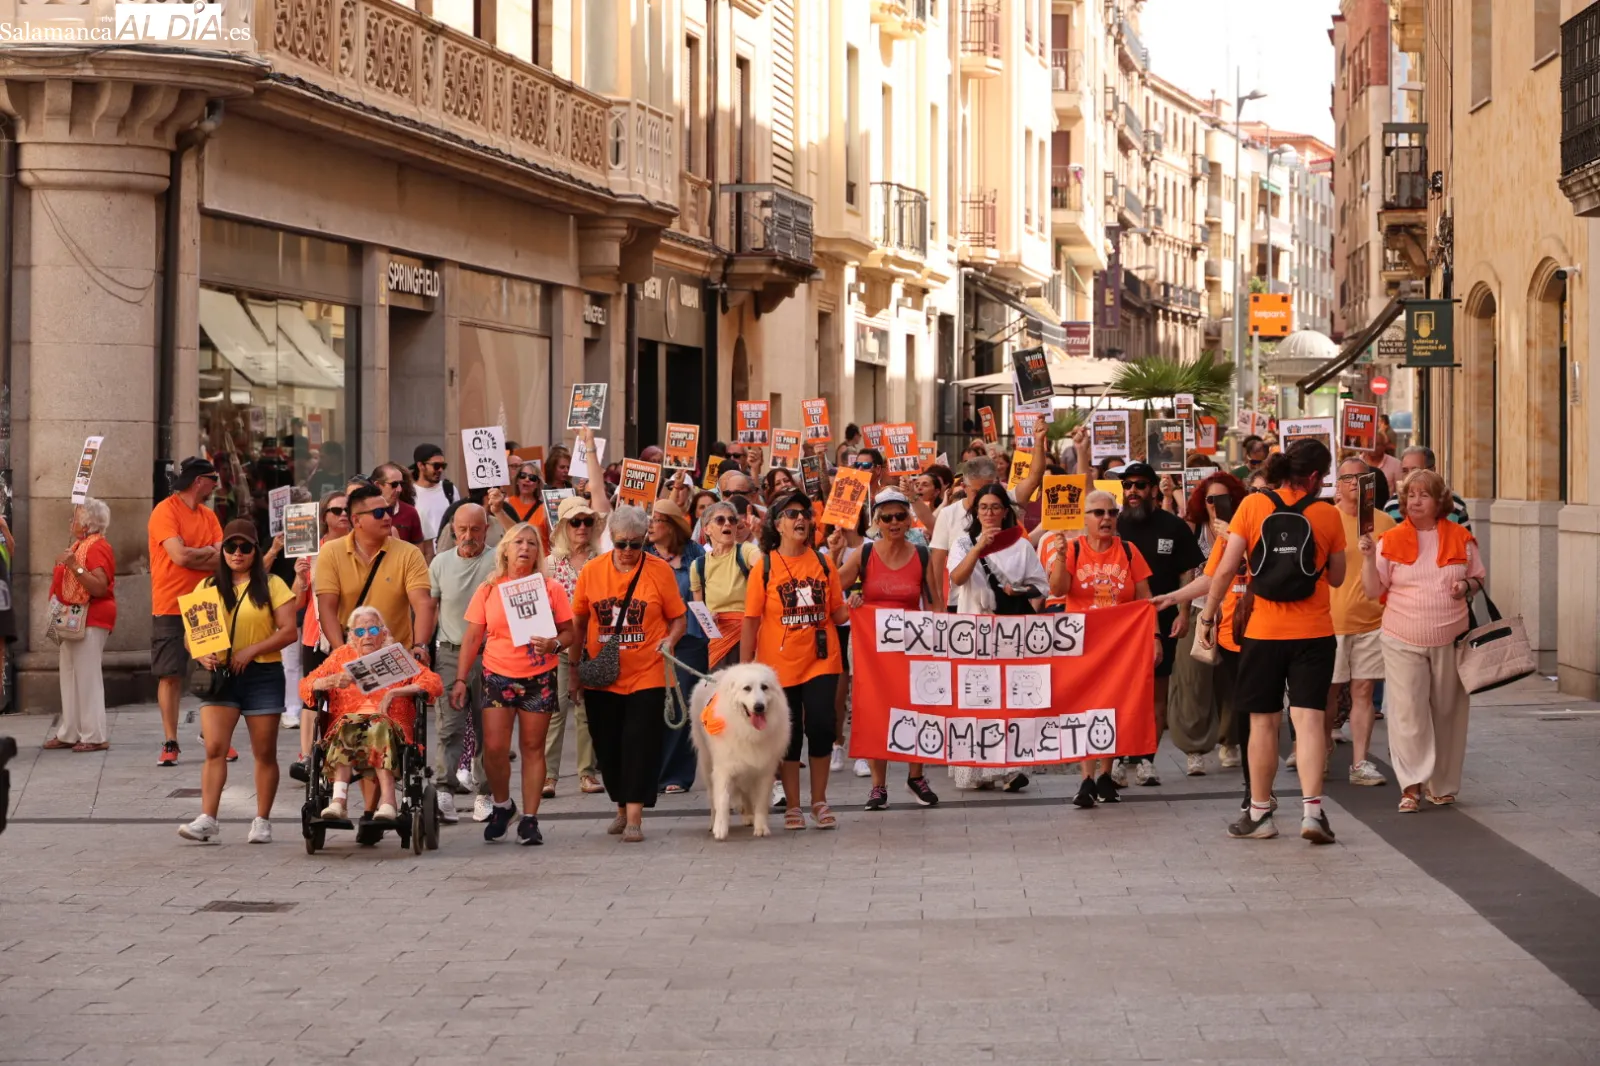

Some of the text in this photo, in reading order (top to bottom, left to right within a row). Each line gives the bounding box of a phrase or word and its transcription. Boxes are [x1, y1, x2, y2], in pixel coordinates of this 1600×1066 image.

[388, 261, 440, 297] SPRINGFIELD
[811, 414, 821, 424] LEY
[1356, 413, 1371, 422] PARA
[746, 419, 758, 428] LEY
[670, 432, 695, 441] CUMPLID
[1163, 431, 1182, 441] SOLA
[894, 444, 907, 455] LEY
[626, 468, 656, 483] CUMPLID
[624, 479, 645, 490] LA LEY
[509, 589, 538, 607] TIENEN
[516, 602, 537, 619] LEY
[634, 633, 645, 641] LEY
[880, 614, 1083, 657] EXIGIMOS
[915, 663, 1043, 706] CER
[888, 715, 1115, 760] COMPLETO
